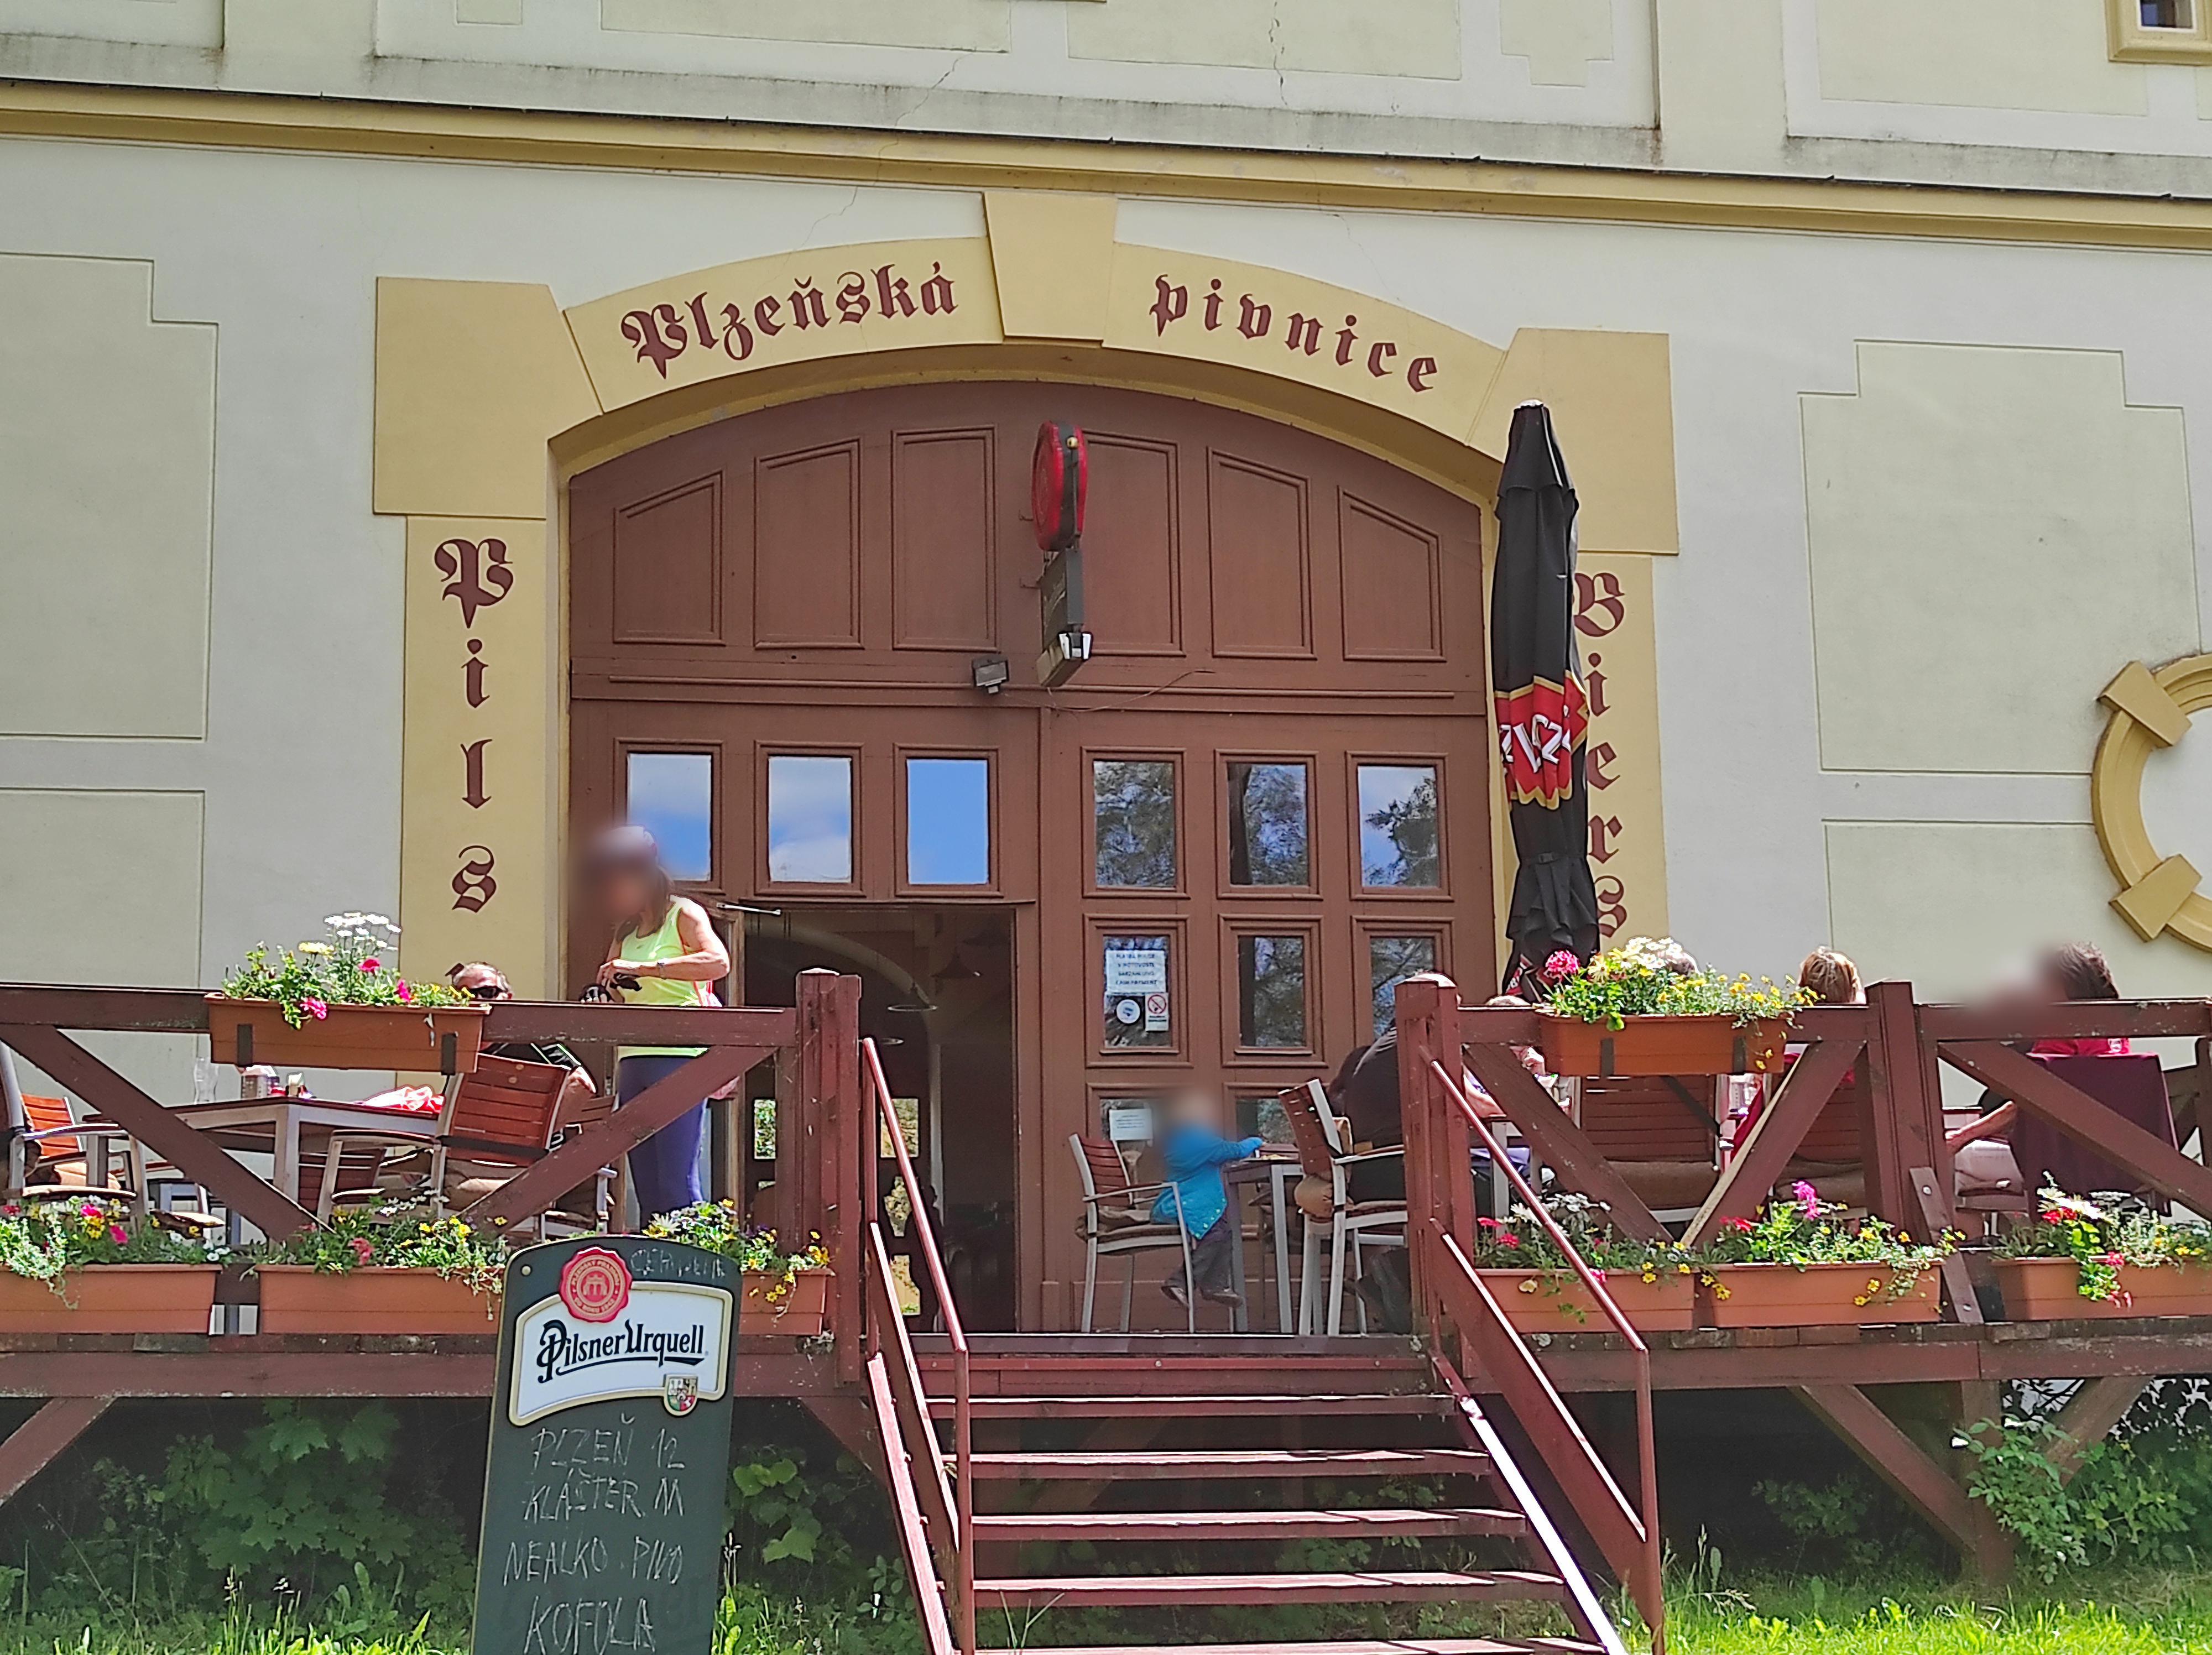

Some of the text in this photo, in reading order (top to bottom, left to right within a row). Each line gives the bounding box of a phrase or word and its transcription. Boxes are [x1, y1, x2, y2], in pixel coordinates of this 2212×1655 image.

[620, 261, 1438, 393] Plzeňská pivnice
[434, 538, 513, 913] Pils
[537, 1319, 704, 1383] Pilsner Urquell
[531, 1412, 685, 1469] PLZEŇ 12
[524, 1468, 645, 1523] KLÁŠTER
[503, 1532, 608, 1586] NEALKO
[524, 1595, 656, 1655] KOFOLA
